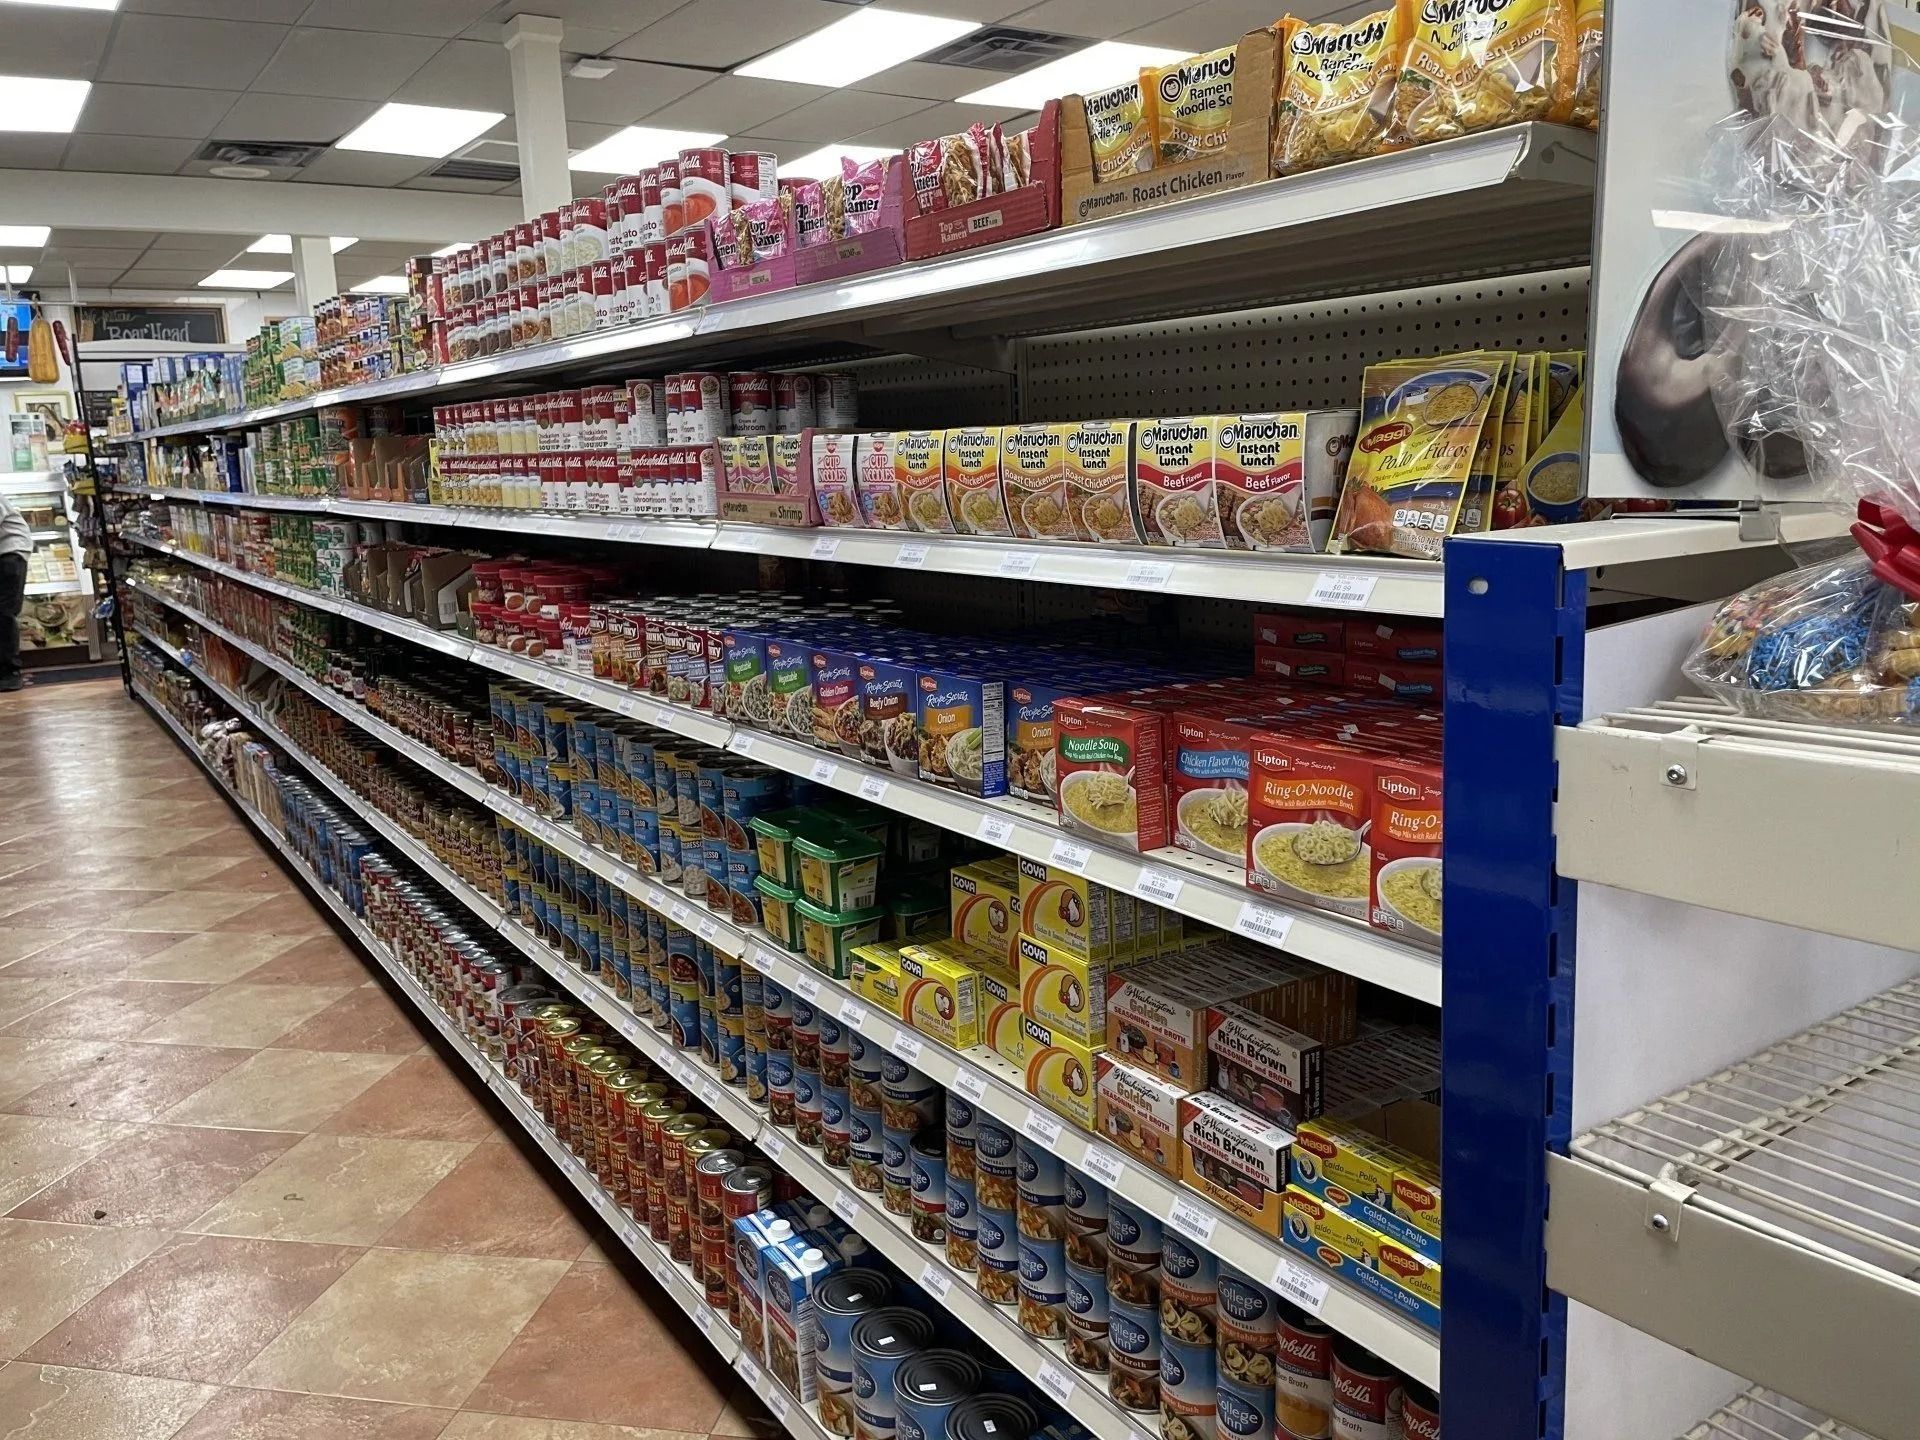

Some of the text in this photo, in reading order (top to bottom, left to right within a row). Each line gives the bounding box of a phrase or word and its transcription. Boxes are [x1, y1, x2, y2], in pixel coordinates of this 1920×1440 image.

[1416, 53, 1452, 84] Roast
[1510, 27, 1547, 51] Flavor
[1190, 82, 1232, 99] Ramen
[1176, 99, 1217, 117] Noodle
[1173, 128, 1202, 146] Roast
[1087, 171, 1245, 211] Maruchan Roast Chicken Flavor
[940, 222, 953, 232] Top
[973, 217, 989, 229] BEEF
[941, 232, 967, 243] Ramen
[1076, 430, 1123, 446] Maruchan
[1152, 425, 1208, 442] Maruchan
[1234, 422, 1299, 440] Maruchan
[1366, 428, 1406, 448] Maggi
[905, 437, 939, 450] Maruchan
[957, 435, 995, 447] Maruchan
[1015, 432, 1060, 447] Maruchan
[959, 449, 984, 458] Instant
[1018, 449, 1048, 458] Instant
[1079, 448, 1110, 458] Instant
[1155, 443, 1193, 454] Instant
[1236, 442, 1280, 454] Instant
[1424, 443, 1469, 460] Fideos
[824, 455, 840, 467] CUP
[869, 454, 888, 467] CUP
[906, 452, 929, 460] Instant
[962, 459, 981, 468] Lunch
[1022, 458, 1045, 469] Lunch
[1083, 458, 1106, 469] Lunch
[1159, 455, 1188, 466] Lunch
[1240, 454, 1275, 465] Lunch
[908, 461, 927, 469] Lunch
[818, 468, 847, 482] NOODLES
[863, 467, 895, 482] NOODLES
[907, 475, 929, 485] Chicken
[959, 473, 983, 484] Chicken
[1005, 469, 1064, 487] Roast Chicken Flavor
[1066, 469, 1125, 488] Roast Chicken Flavor
[1163, 472, 1202, 488] Beef Flavor
[1245, 472, 1290, 490] Beef Flavor
[779, 507, 803, 523] Shrimp
[820, 685, 848, 696] Golden Onion
[921, 680, 937, 688] Lipton
[870, 696, 898, 709] Beefy Onion
[927, 692, 968, 706] Recipe Secrets
[1013, 692, 1031, 700] Lipton
[938, 713, 955, 724] Onion
[1019, 707, 1040, 720] Recipe
[1061, 714, 1082, 726] Lipton
[1032, 727, 1051, 738] Onion
[1180, 725, 1204, 738] Lipton
[1068, 739, 1119, 752] Noodle Soup
[1181, 752, 1232, 767] Chicken Flavor
[1257, 753, 1310, 766] Lipton Soup
[1265, 781, 1354, 799] Ring-O-Noodle
[1381, 781, 1416, 796] Lipton
[1264, 796, 1274, 805] Soup
[1339, 801, 1353, 810] Broth
[1389, 826, 1401, 835] Soup
[729, 864, 745, 872] RESSO
[1022, 859, 1045, 880] GOYA
[954, 877, 976, 894] GOYA
[1022, 942, 1046, 964] GOYA
[902, 957, 922, 978] GOYA
[986, 978, 1007, 1001] GOYA
[1130, 999, 1167, 1025] Golden
[1114, 1006, 1185, 1044] SEASONING and BROTH
[1026, 1022, 1050, 1044] GOYA
[1218, 1029, 1286, 1074] Rich Brown
[1214, 1044, 1292, 1087] SEASONING and BROTH
[1117, 1082, 1152, 1112] Golden
[1103, 1089, 1170, 1132] SEASONING and BROTH
[1193, 1122, 1264, 1170] Rich Brown
[1301, 1136, 1333, 1154] Maggi
[1189, 1136, 1269, 1184] SEASONING and BROTH
[992, 1167, 1013, 1176] broth
[1325, 1159, 1377, 1183] Caldo Pollo
[1397, 1186, 1430, 1205] Maggi
[1288, 1197, 1321, 1216] Maggi
[1364, 1206, 1427, 1246] Caldo Pollo
[1346, 1234, 1364, 1247] Pollo
[1119, 1251, 1137, 1261] broth
[1382, 1251, 1418, 1271] Maggi
[1355, 1268, 1419, 1310] Caldo Pollo
[1409, 1277, 1432, 1292] Caldo
[1220, 1282, 1263, 1310] College
[1227, 1299, 1248, 1318] Inn
[1072, 1317, 1091, 1329] broth
[1115, 1335, 1132, 1350] Inn
[1127, 1357, 1147, 1368] broth
[1289, 1379, 1308, 1389] Broth
[1224, 1412, 1244, 1431] Inn
[1342, 1419, 1362, 1432] Broth
